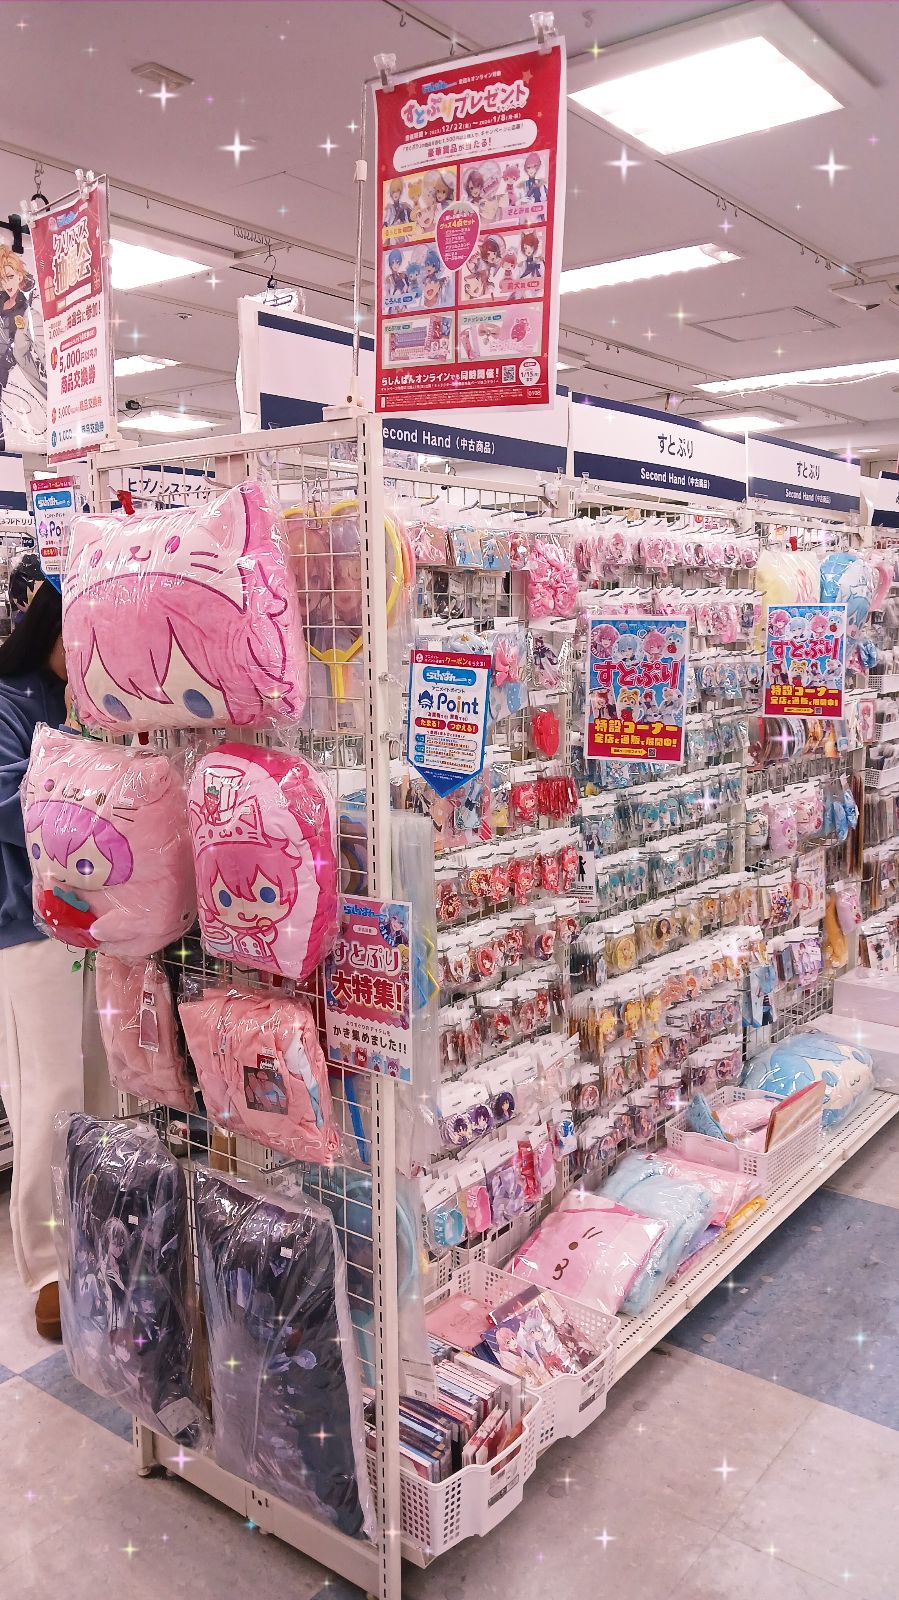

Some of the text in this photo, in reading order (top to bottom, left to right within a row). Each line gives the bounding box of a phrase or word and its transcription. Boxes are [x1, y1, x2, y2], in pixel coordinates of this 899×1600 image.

[60, 364, 96, 396] 商品交換券
[382, 428, 496, 455] econd Hand (中古商品)
[657, 432, 694, 460] すとぷり
[640, 468, 710, 490] Second Hand (中古商品)
[796, 461, 821, 481] すとぷり
[785, 488, 802, 501] Second
[802, 490, 815, 502] Hand
[770, 638, 840, 660] すとぷり
[593, 660, 681, 689] すとぷり
[432, 686, 466, 694] アニメイトポイント
[770, 684, 839, 696] 特設コーナー
[437, 693, 479, 714] Point
[420, 719, 476, 733] たまる! つかえる!
[594, 719, 679, 735] 特設コーナー
[334, 940, 400, 976] すとぷり
[331, 970, 404, 1012] 大特集!
[332, 1024, 407, 1054] かき集めました!!
